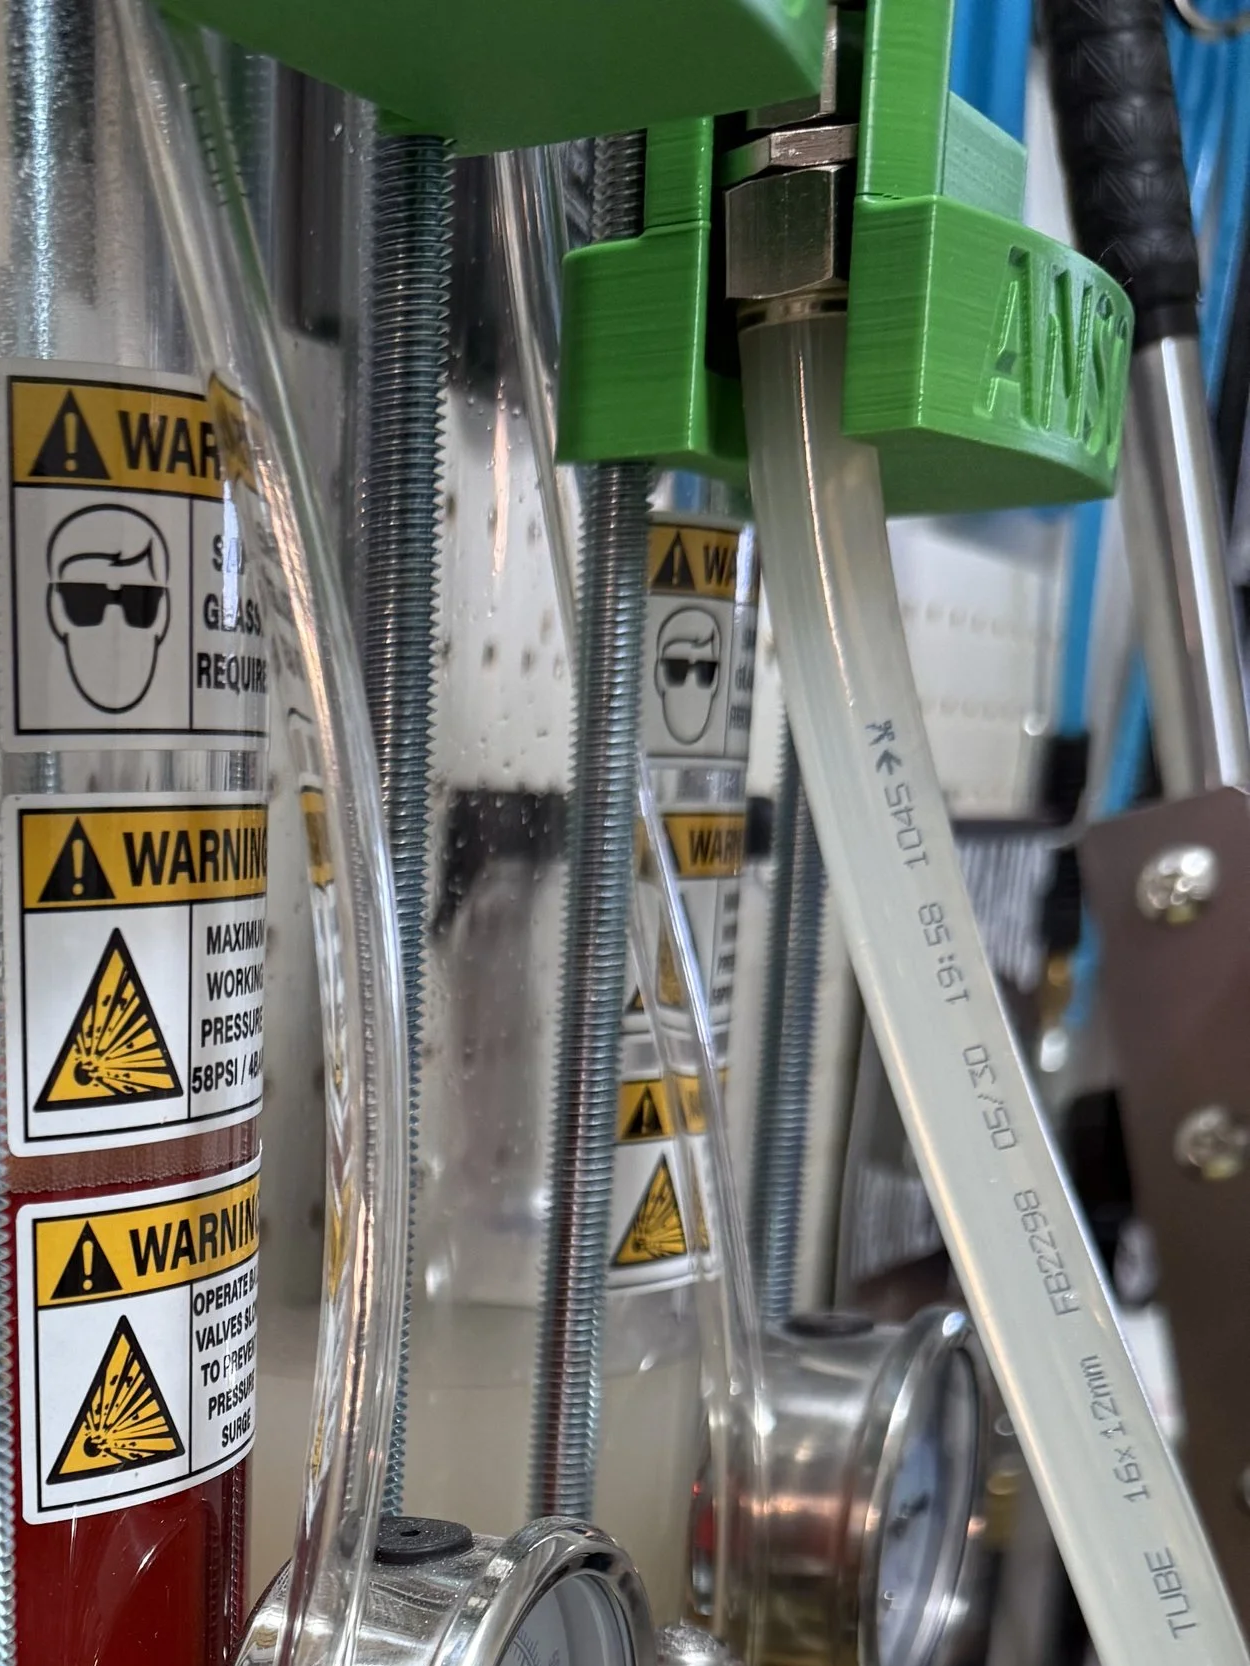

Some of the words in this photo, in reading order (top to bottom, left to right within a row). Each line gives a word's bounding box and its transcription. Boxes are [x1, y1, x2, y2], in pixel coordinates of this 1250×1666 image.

[883, 783, 930, 870] 1045
[917, 902, 971, 1007] 19:58
[200, 1005, 263, 1048] PRESSURE
[191, 1058, 238, 1094] 58PSI
[961, 1044, 1017, 1151] 05/30
[1012, 1189, 1081, 1316] FB2298
[193, 1272, 249, 1317] OPERATE
[195, 1311, 243, 1353] VALVES
[200, 1359, 221, 1387] TO
[221, 1406, 252, 1448] SURGE
[1143, 1546, 1198, 1640] TUBE
